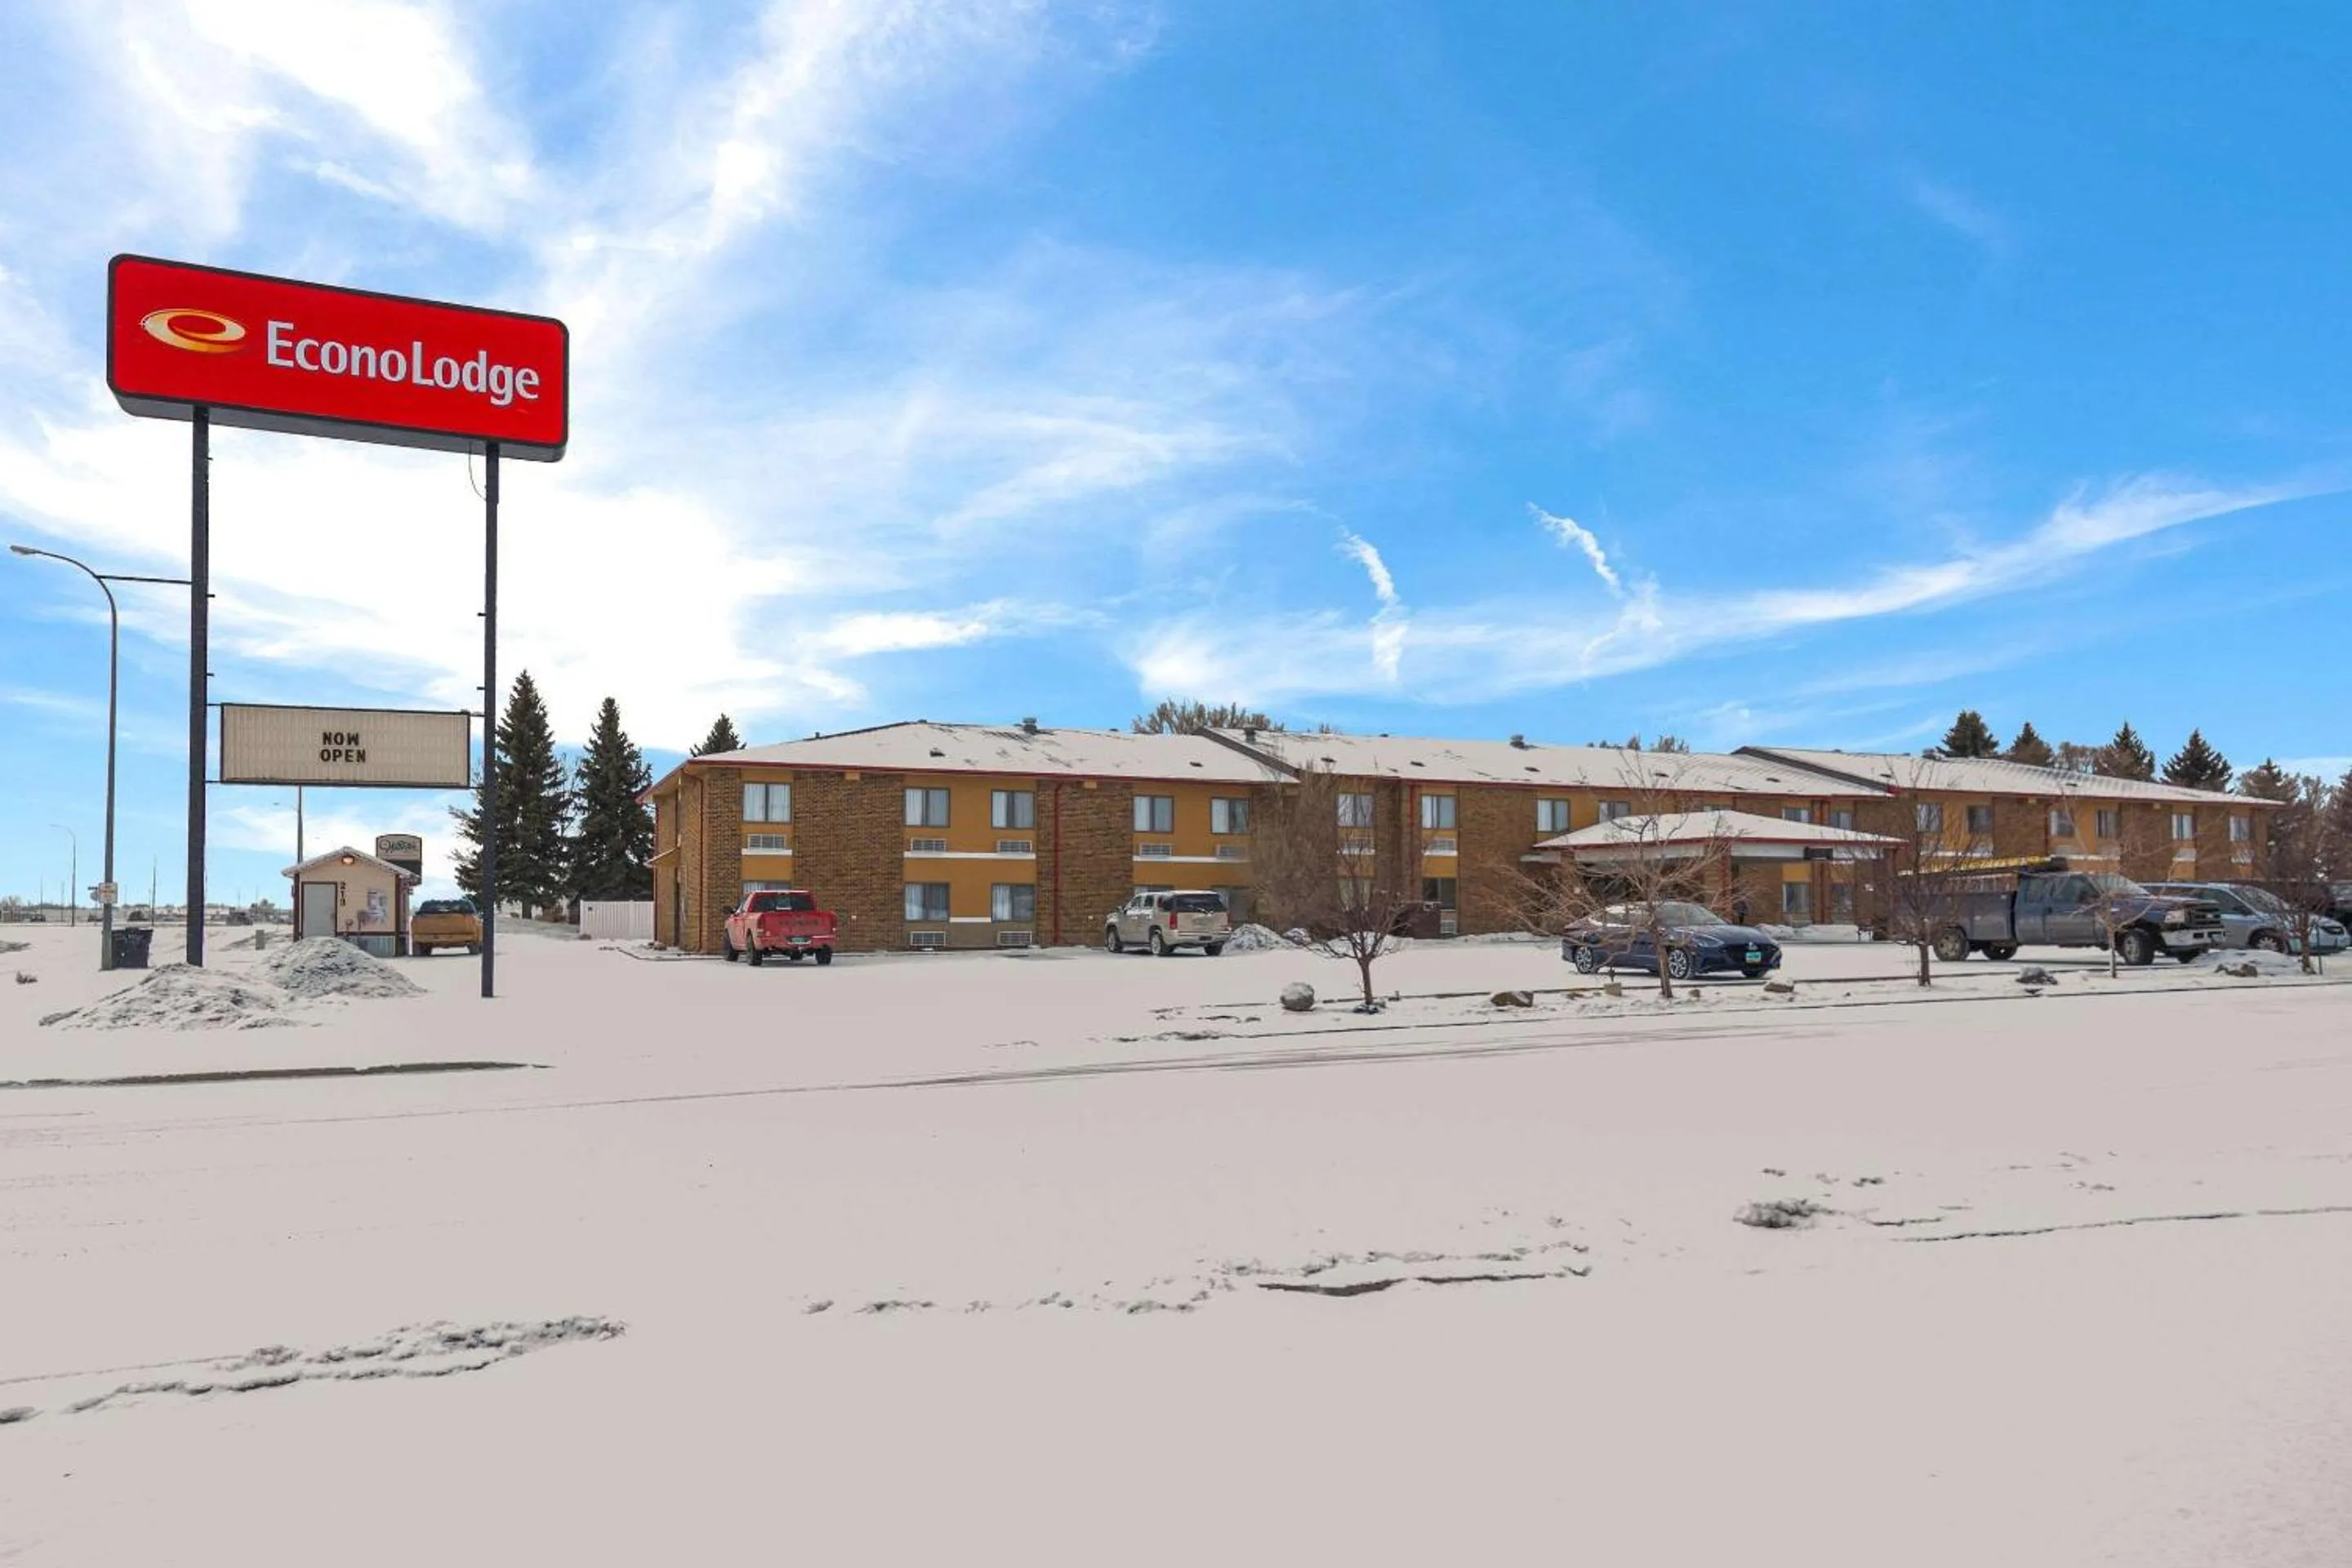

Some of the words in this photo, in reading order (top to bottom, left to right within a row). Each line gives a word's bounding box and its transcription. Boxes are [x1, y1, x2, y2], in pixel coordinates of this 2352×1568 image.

[266, 320, 539, 405] EconoLodge
[323, 732, 359, 746] NOW
[319, 749, 366, 763] OPEN
